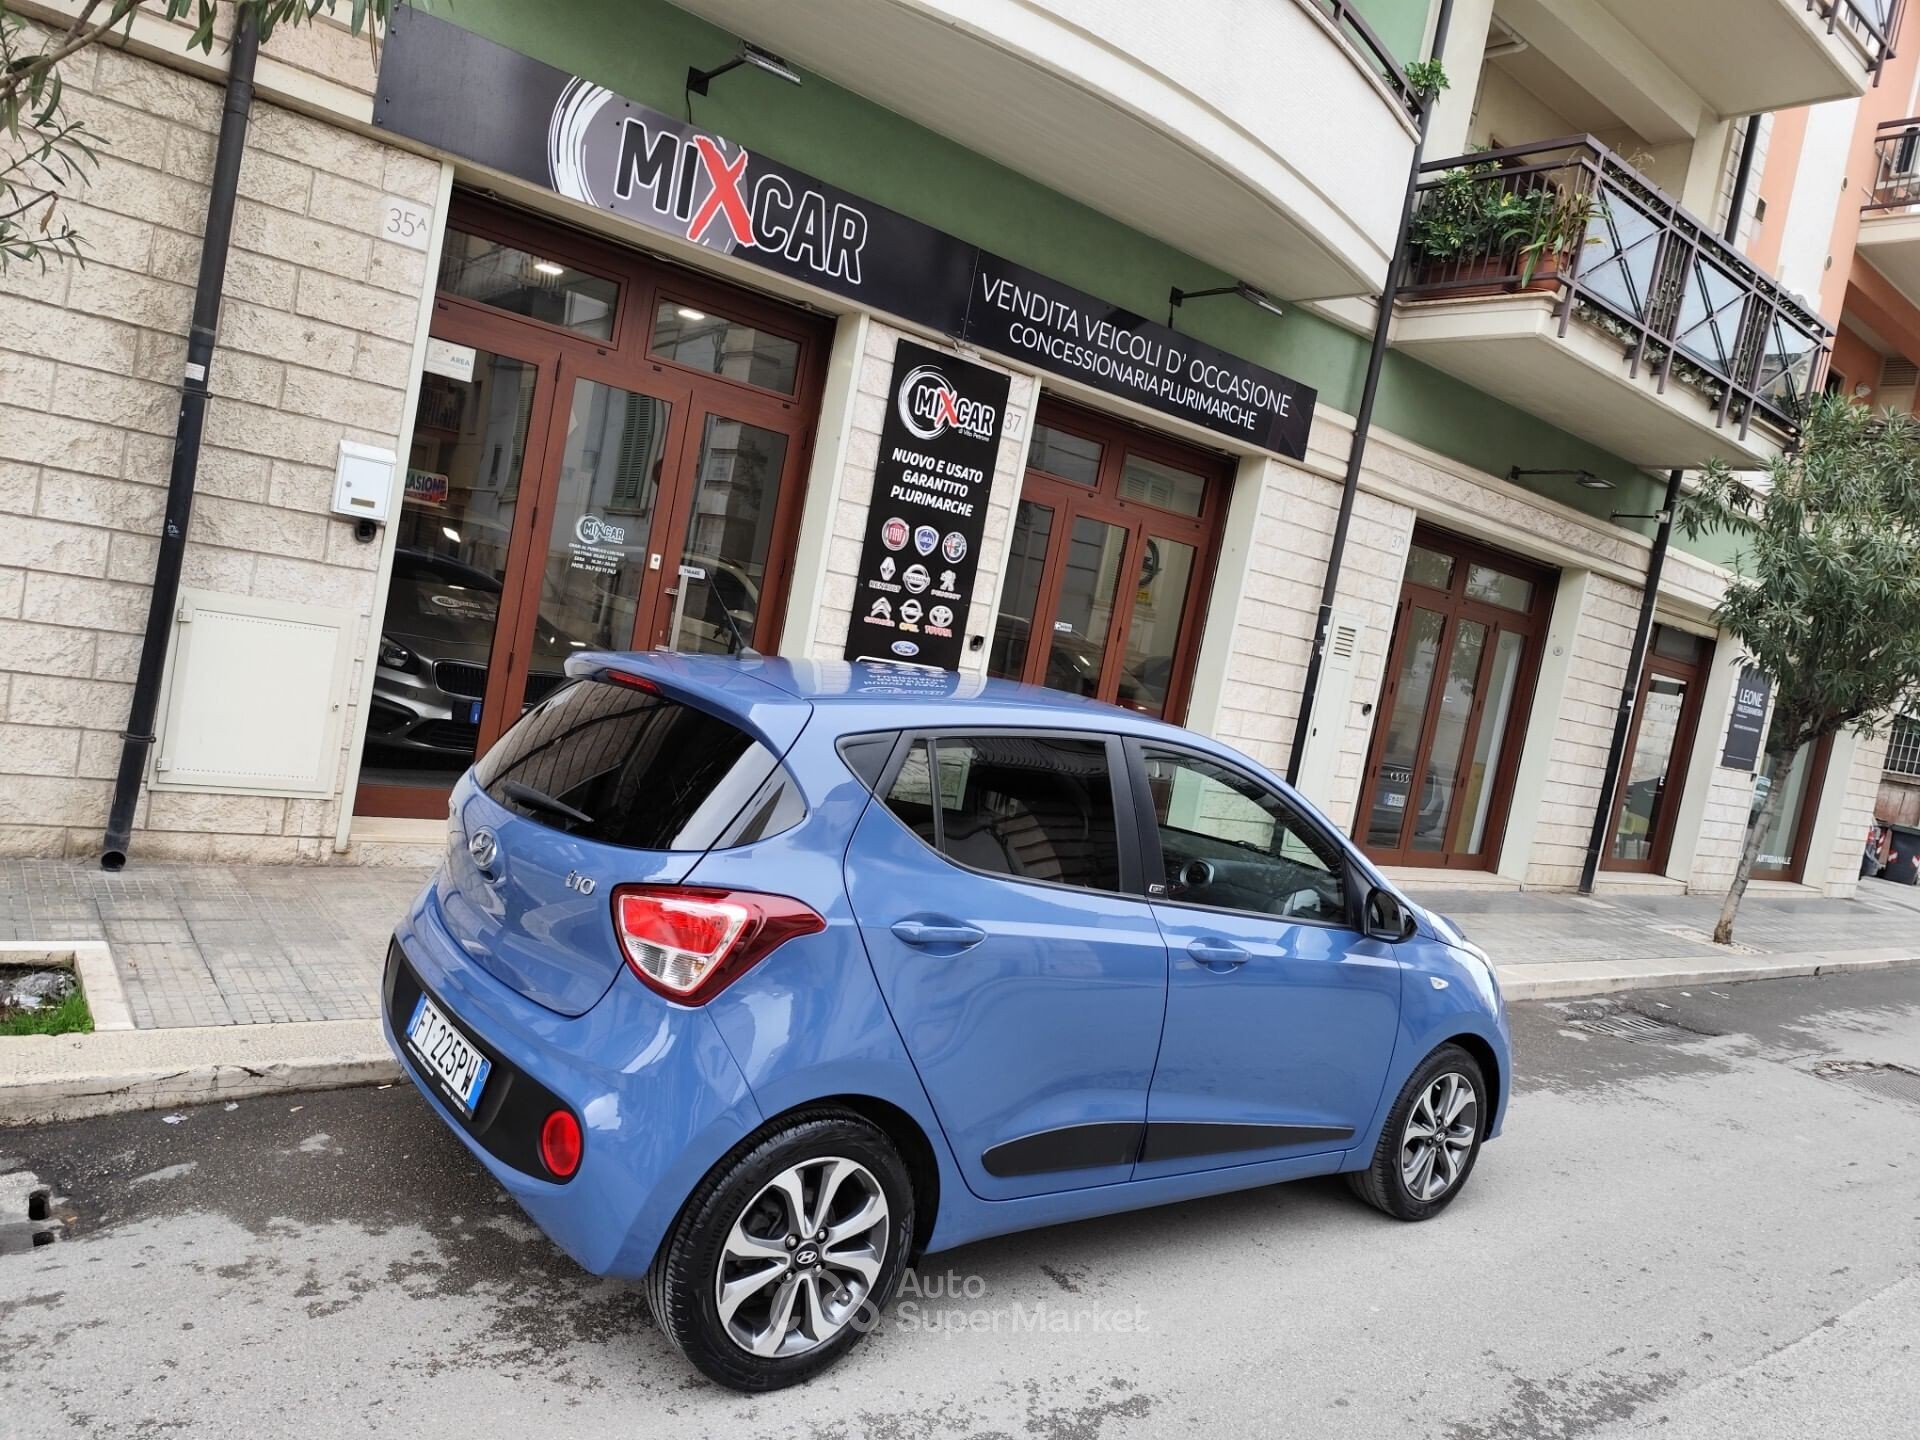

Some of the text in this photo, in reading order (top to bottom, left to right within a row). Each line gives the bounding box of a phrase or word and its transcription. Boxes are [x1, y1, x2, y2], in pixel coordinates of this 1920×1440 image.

[613, 116, 868, 285] MIXCAR
[982, 272, 1080, 338] VENDITA
[1084, 314, 1162, 368] VEICOLI
[1189, 358, 1292, 418] OCCASIONE
[1009, 321, 1258, 431] CONCESSIONARIA PLURIMARCHE
[914, 384, 996, 437] MIXCAR
[1004, 412, 1022, 433] 37
[891, 447, 984, 484] NUOVO E USATO
[902, 469, 969, 498] GARANTITO
[890, 485, 974, 517] PLURIMARCHE
[583, 520, 625, 541] MIXCAR
[889, 526, 906, 542] FIAT
[868, 580, 902, 594] RENAULT
[905, 575, 927, 584] NISSAN
[1739, 687, 1764, 707] LEONE
[566, 870, 596, 895] i10
